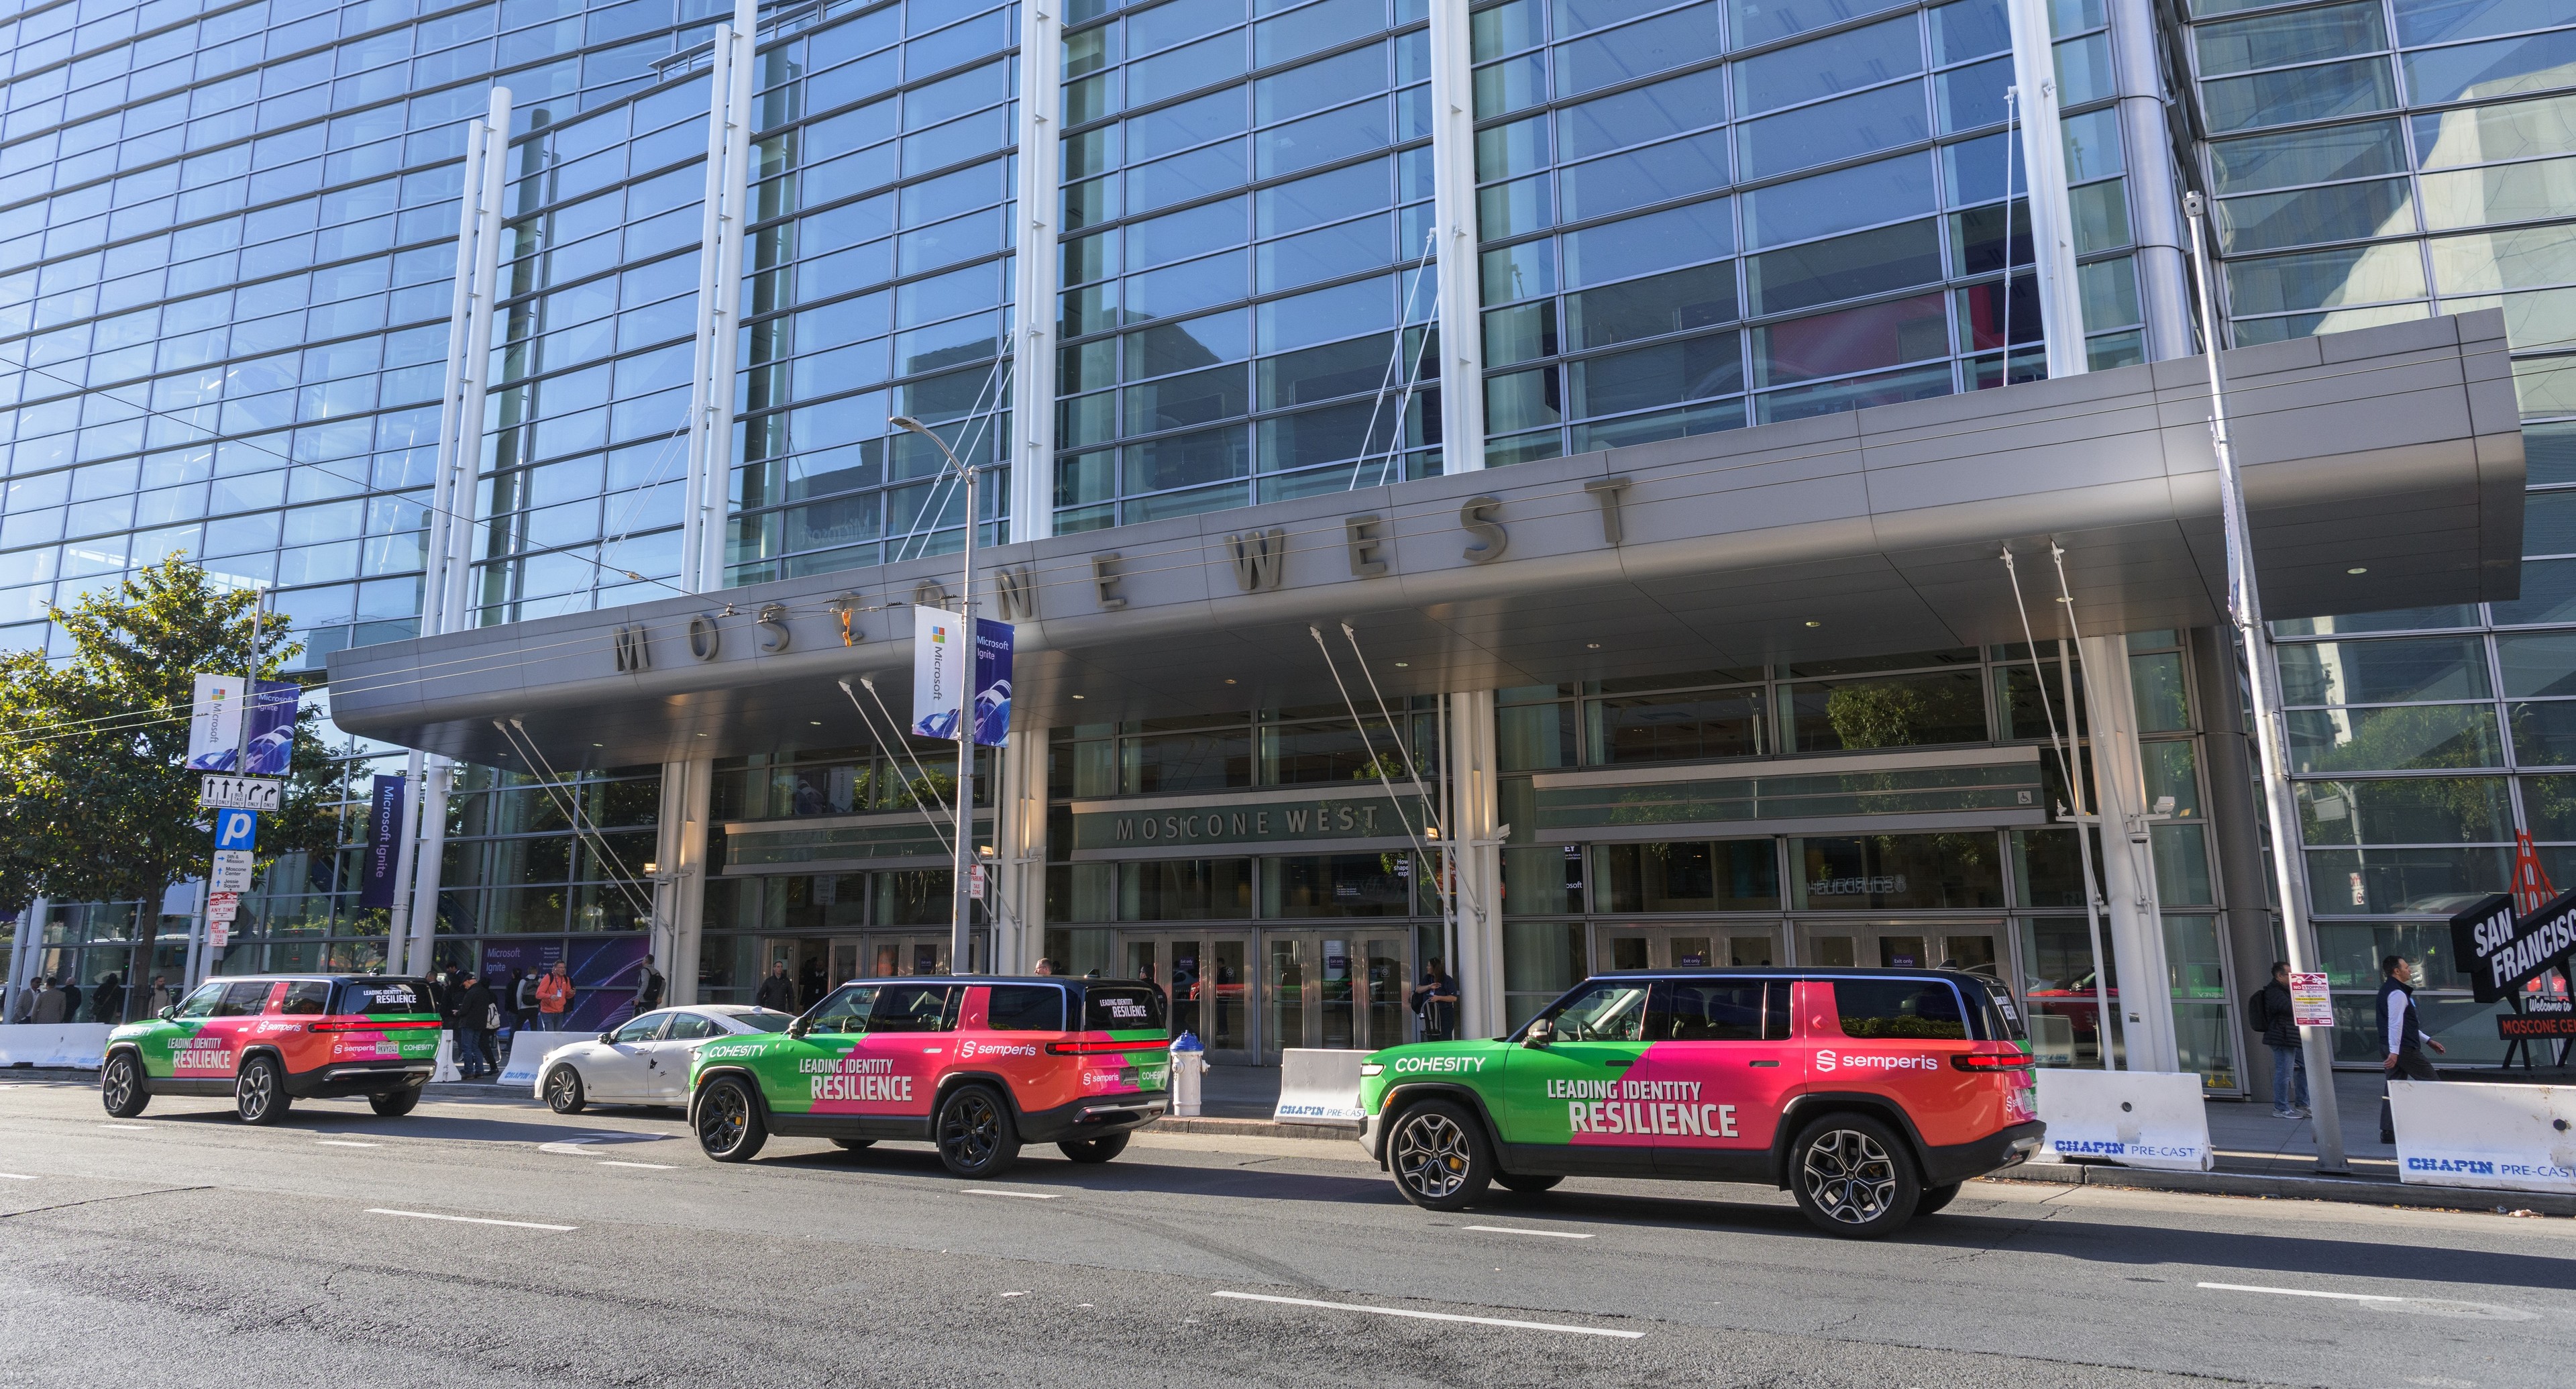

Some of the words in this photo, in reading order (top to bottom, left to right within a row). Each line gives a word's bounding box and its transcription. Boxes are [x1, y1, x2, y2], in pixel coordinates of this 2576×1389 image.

[612, 554, 1126, 671] MOSCONE
[1224, 477, 1633, 591] WEST
[977, 635, 1009, 651] Microsoft
[977, 648, 996, 660] Ignite
[933, 646, 943, 701] Microsoft
[258, 694, 293, 704] Microsoft
[258, 703, 278, 712] Ignite
[210, 703, 221, 743] Microsoft
[381, 786, 394, 841] Microsoft
[1116, 811, 1269, 841] MOSCONE
[1285, 805, 1377, 833] WEST
[376, 845, 390, 878] Ignite
[2474, 907, 2514, 958] SAN
[488, 947, 521, 958] Microsoft
[486, 962, 506, 974] Ignite
[376, 994, 417, 1004] RESILIENCE
[2529, 998, 2563, 1012] Welcome
[2563, 1000, 2572, 1012] to
[1112, 1005, 1147, 1017] RESILIENCE
[117, 1027, 154, 1036] HESITY
[267, 1023, 302, 1032] semperis
[2502, 1019, 2558, 1034] MOSCONE
[168, 1039, 193, 1049] LEADING
[193, 1038, 222, 1049] IDENTITY
[978, 1043, 1036, 1056] semperis
[709, 1045, 767, 1058] COHESITY
[173, 1051, 231, 1069] RESILIENCE
[799, 1058, 842, 1074] LEADING
[845, 1059, 894, 1074] IDENTITY
[1395, 1057, 1486, 1072] COHESITY
[1843, 1055, 1938, 1070] semperis
[1093, 1074, 1119, 1082] semperis
[810, 1076, 913, 1101] RESILIENCE
[1547, 1080, 1618, 1100] LEADING
[1623, 1080, 1702, 1102] IDENTITY
[1279, 1105, 1325, 1116] CHAPIN
[1326, 1109, 1367, 1117] PRE-CAST
[1568, 1101, 1739, 1138] RESILIENCE
[2055, 1140, 2125, 1154] CHAPIN
[2132, 1145, 2195, 1157] PRE-CAST
[2407, 1158, 2494, 1174] CHAPIN
